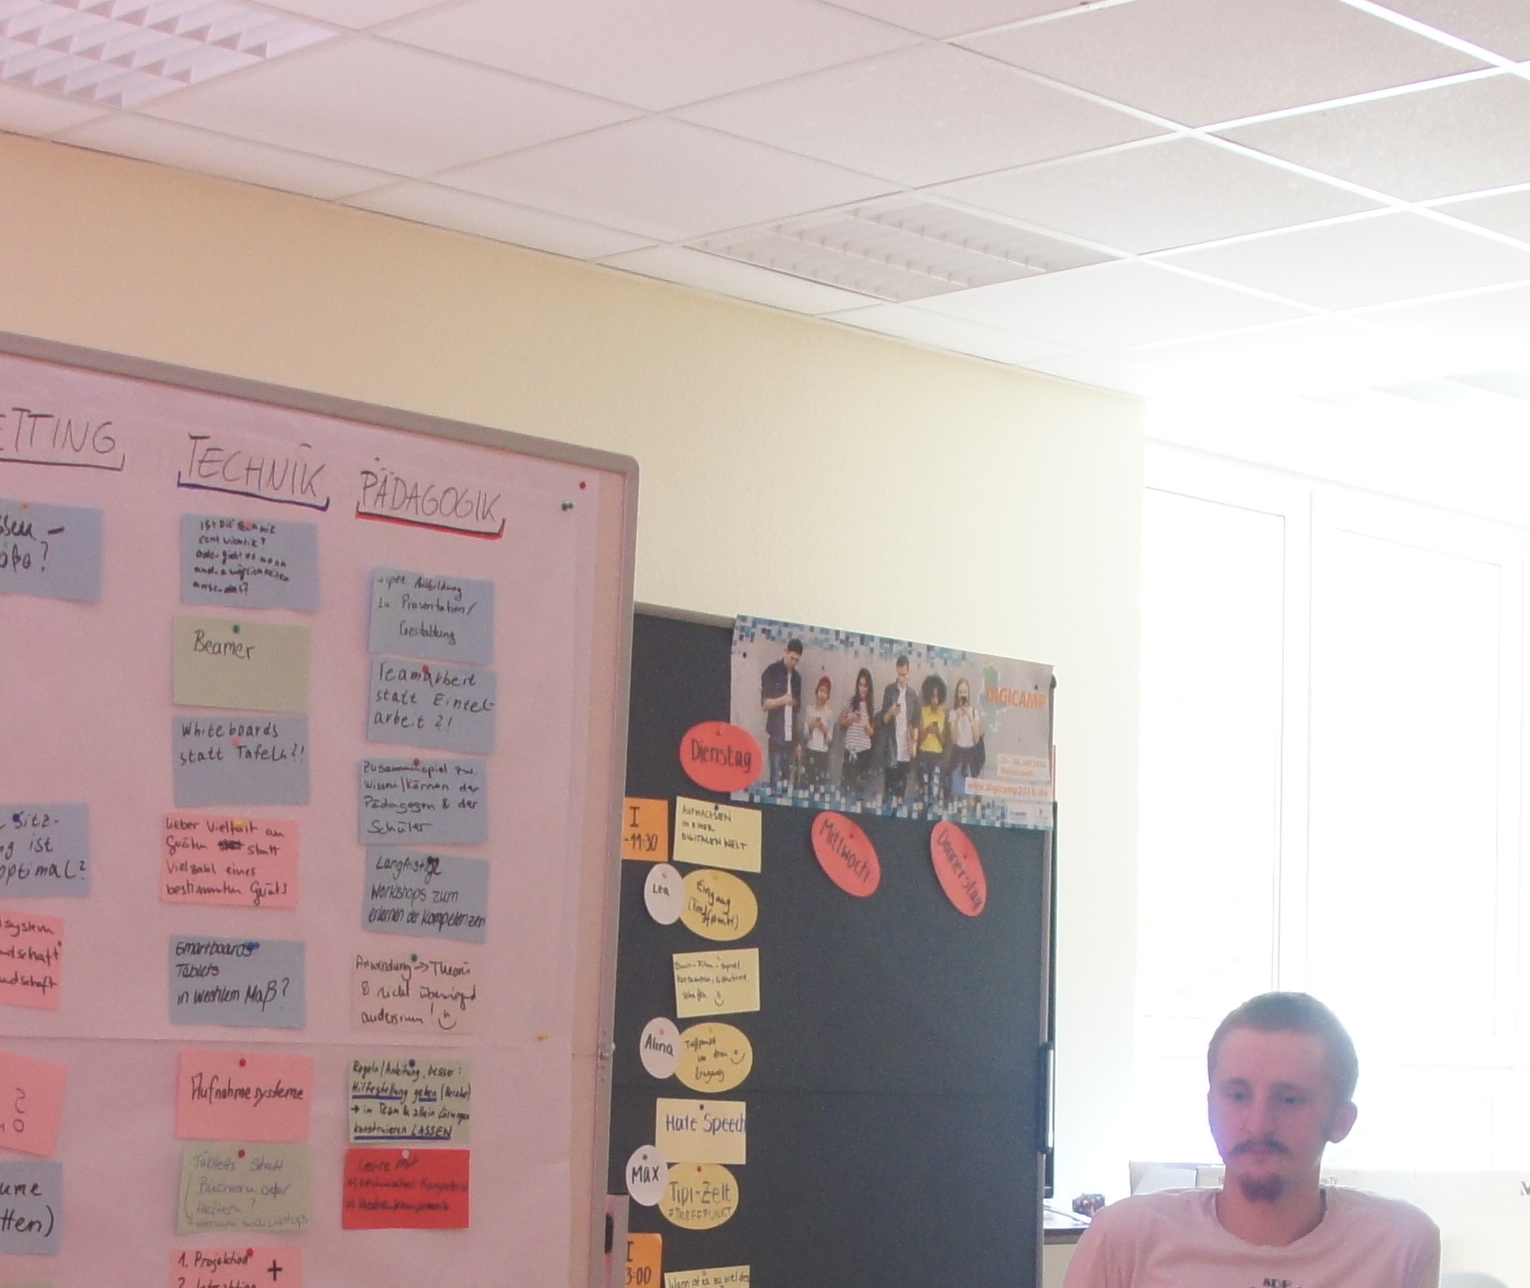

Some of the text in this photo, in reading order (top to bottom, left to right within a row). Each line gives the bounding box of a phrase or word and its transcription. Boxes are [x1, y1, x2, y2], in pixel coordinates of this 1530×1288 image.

[188, 433, 325, 497] TECHNIK
[360, 467, 501, 521] PÄDAGOGIK
[194, 629, 256, 659] Beamer
[376, 690, 418, 705] statt
[986, 684, 1048, 711] DIGICAMP
[374, 710, 425, 728] arbeit
[180, 747, 224, 766] statt
[691, 738, 752, 773] Dienstag
[30, 834, 54, 852] ist
[819, 818, 870, 883] Mittwoch
[937, 829, 982, 911] Donnerstag
[653, 883, 670, 896] Lea
[645, 1033, 674, 1057] Alina
[412, 1125, 452, 1136] LASSEN
[665, 1114, 697, 1132] Hate
[631, 1165, 659, 1184] Max
[669, 1181, 731, 1206] Tipi-Zelt
